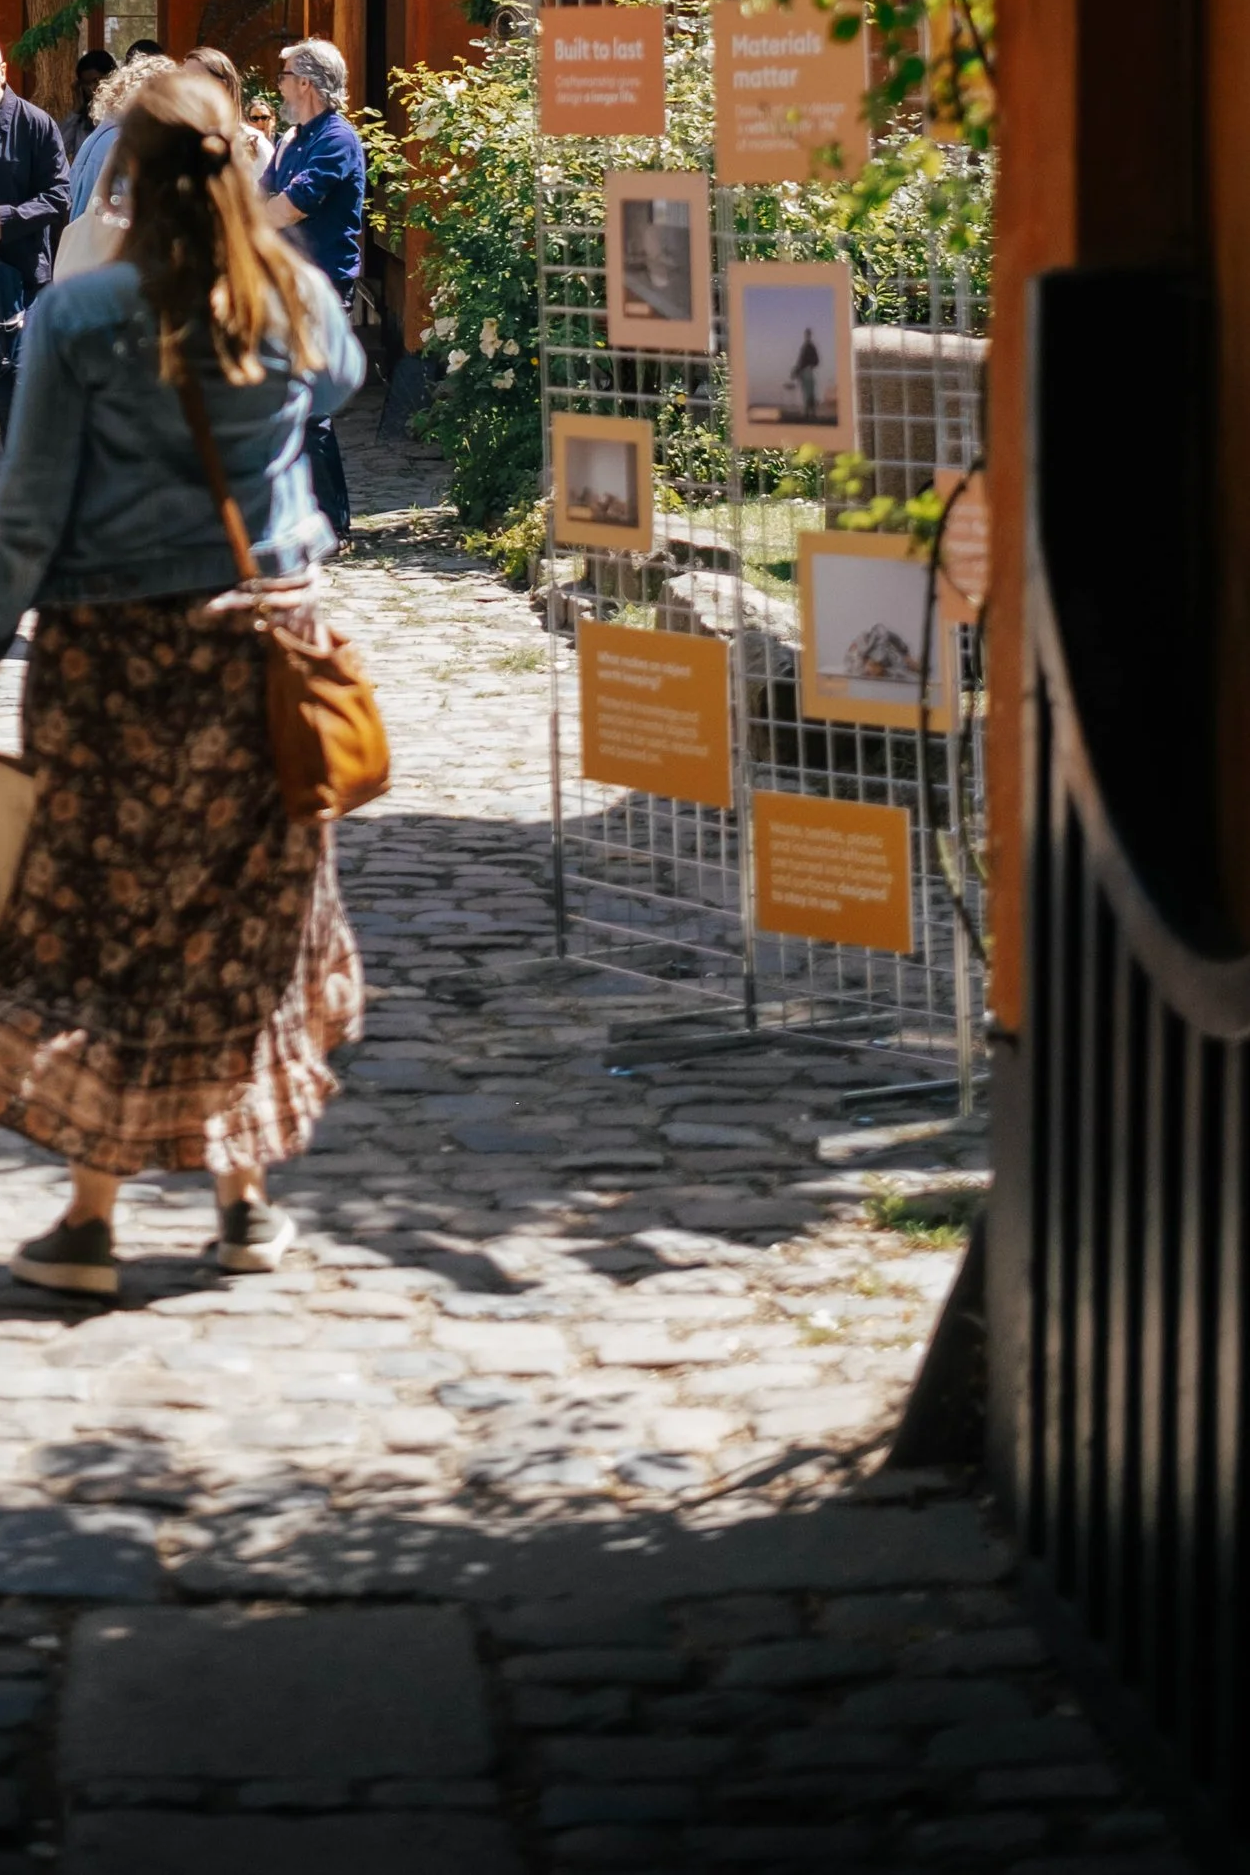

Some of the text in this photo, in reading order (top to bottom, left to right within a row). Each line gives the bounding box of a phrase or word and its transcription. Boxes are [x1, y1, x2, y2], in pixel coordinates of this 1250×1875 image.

[554, 36, 645, 61] Built to last
[732, 29, 823, 58] Materials
[733, 65, 798, 89] matter
